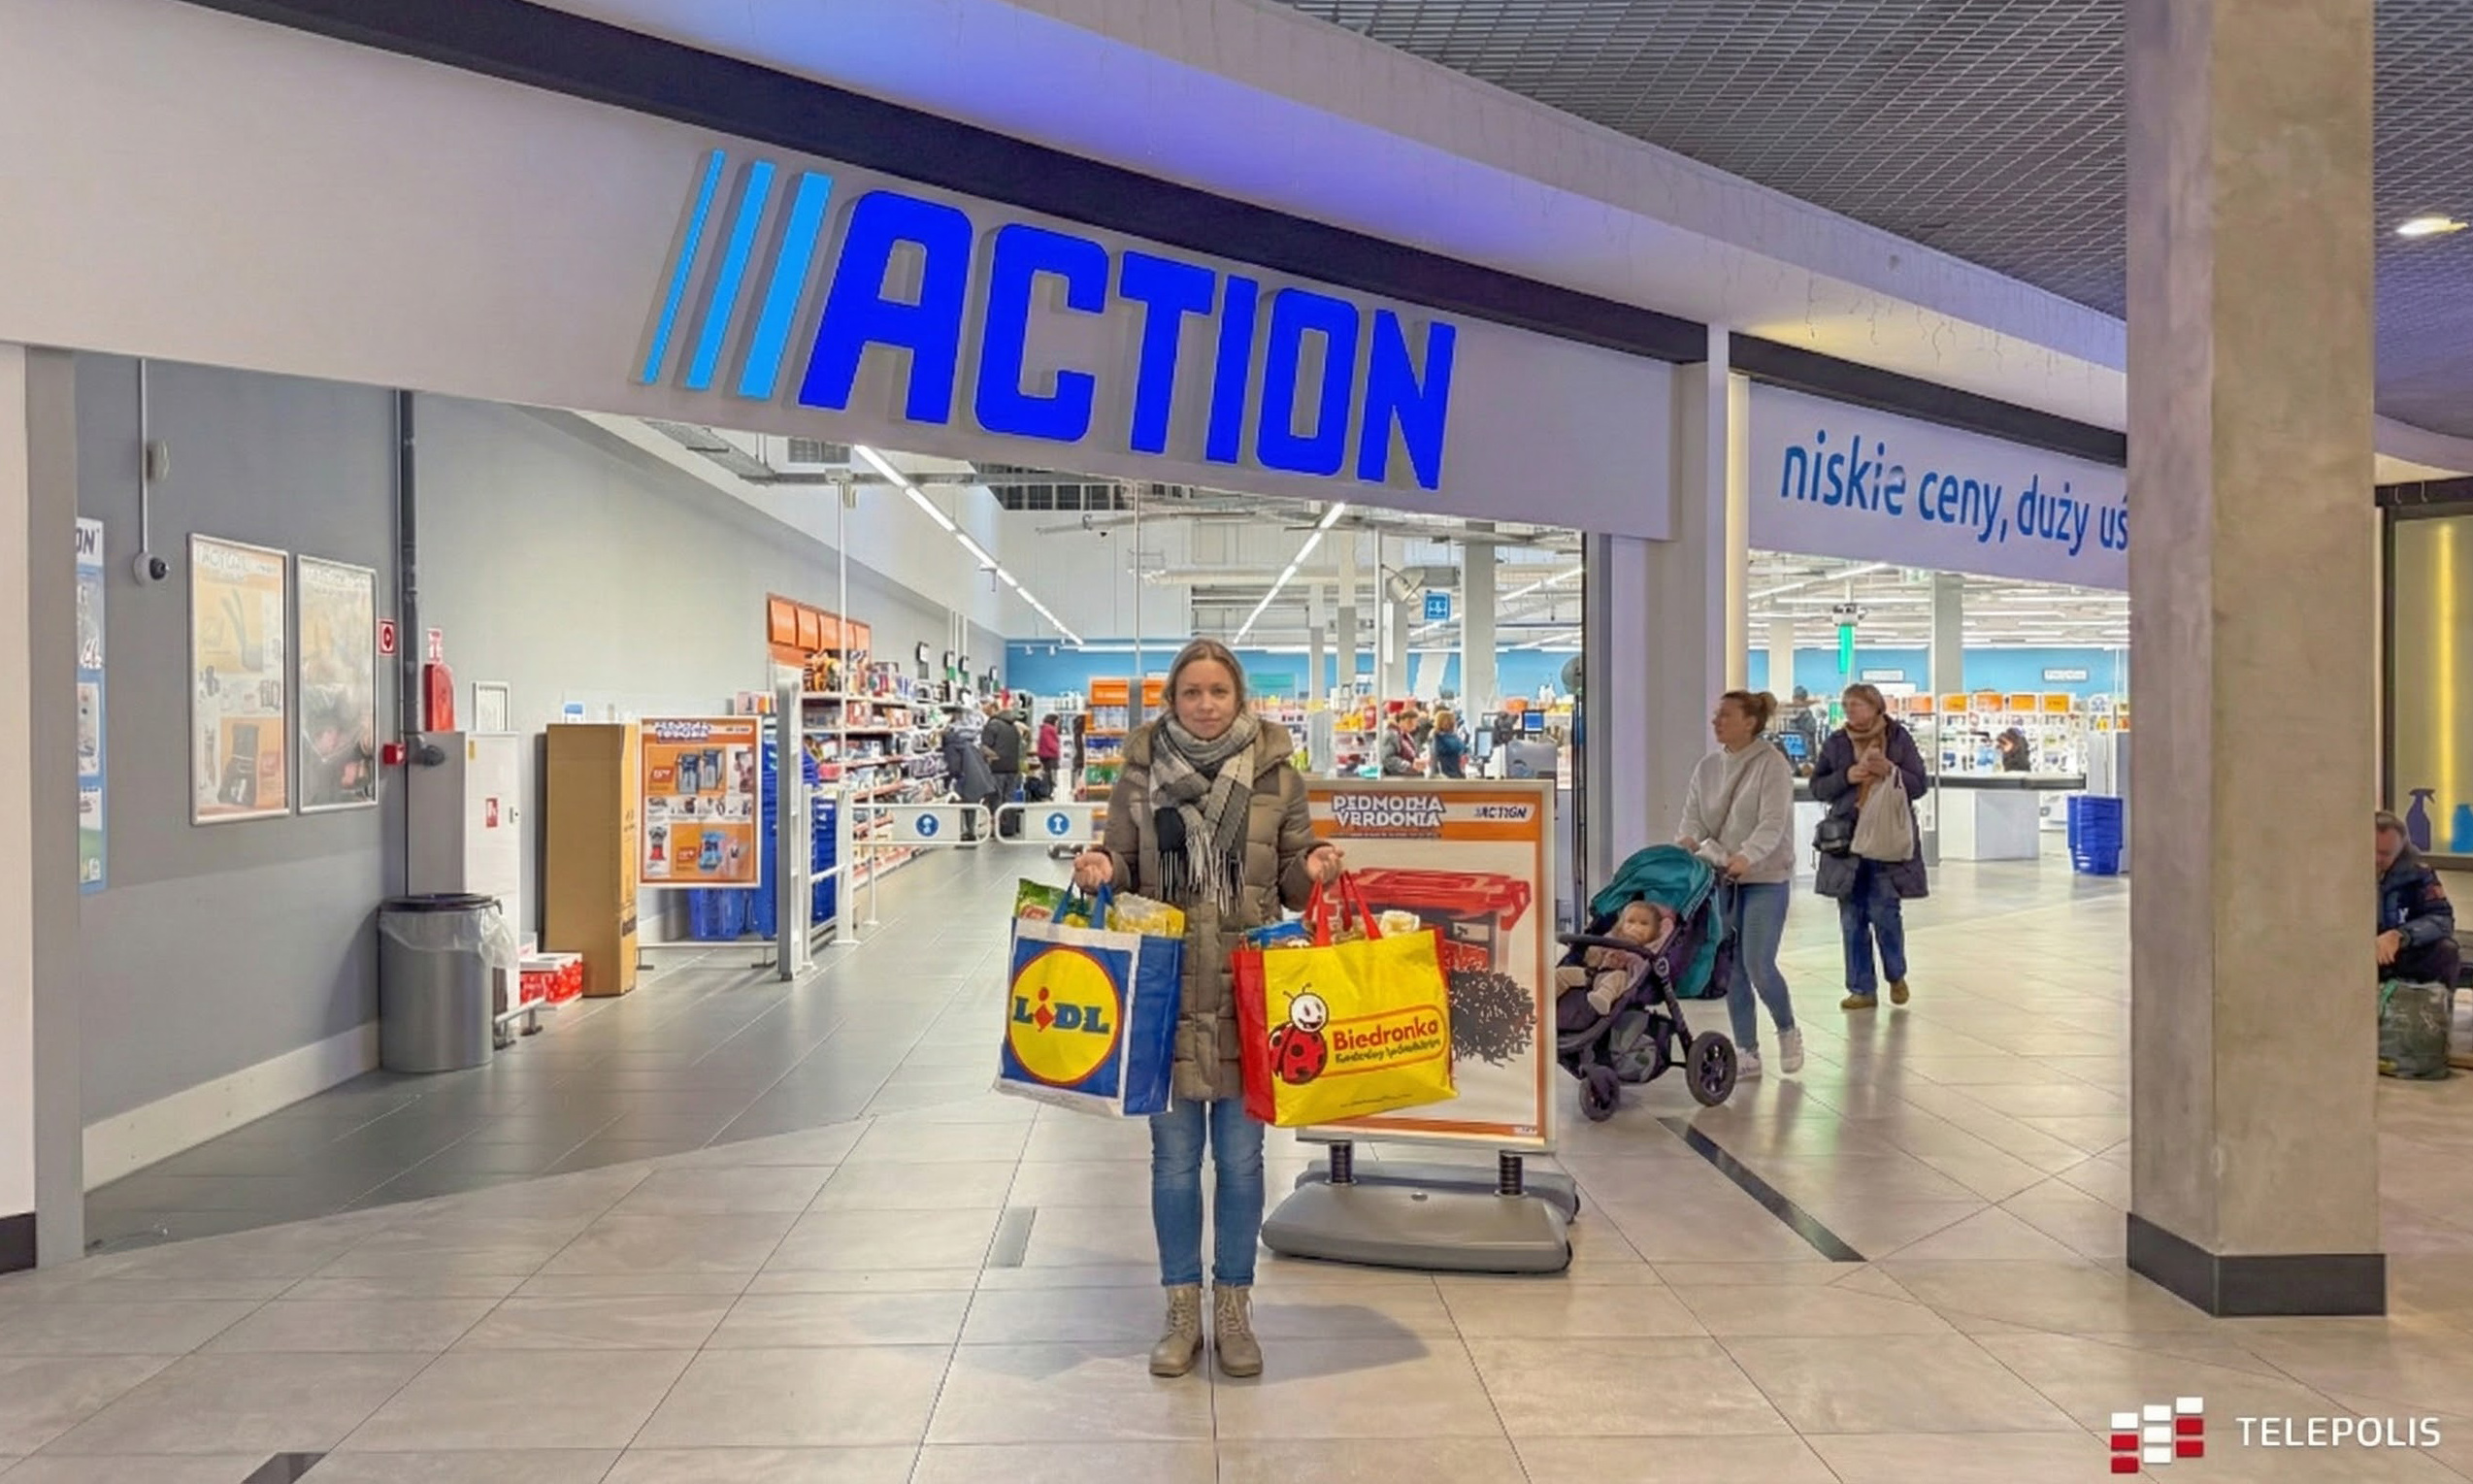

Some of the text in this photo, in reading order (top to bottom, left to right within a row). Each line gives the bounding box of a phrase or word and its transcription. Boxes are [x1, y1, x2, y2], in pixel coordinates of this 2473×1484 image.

[799, 189, 1456, 491] ACTION
[1781, 429, 1906, 515] niskie
[1918, 471, 2008, 544] ceny,
[2018, 474, 2090, 556] duży
